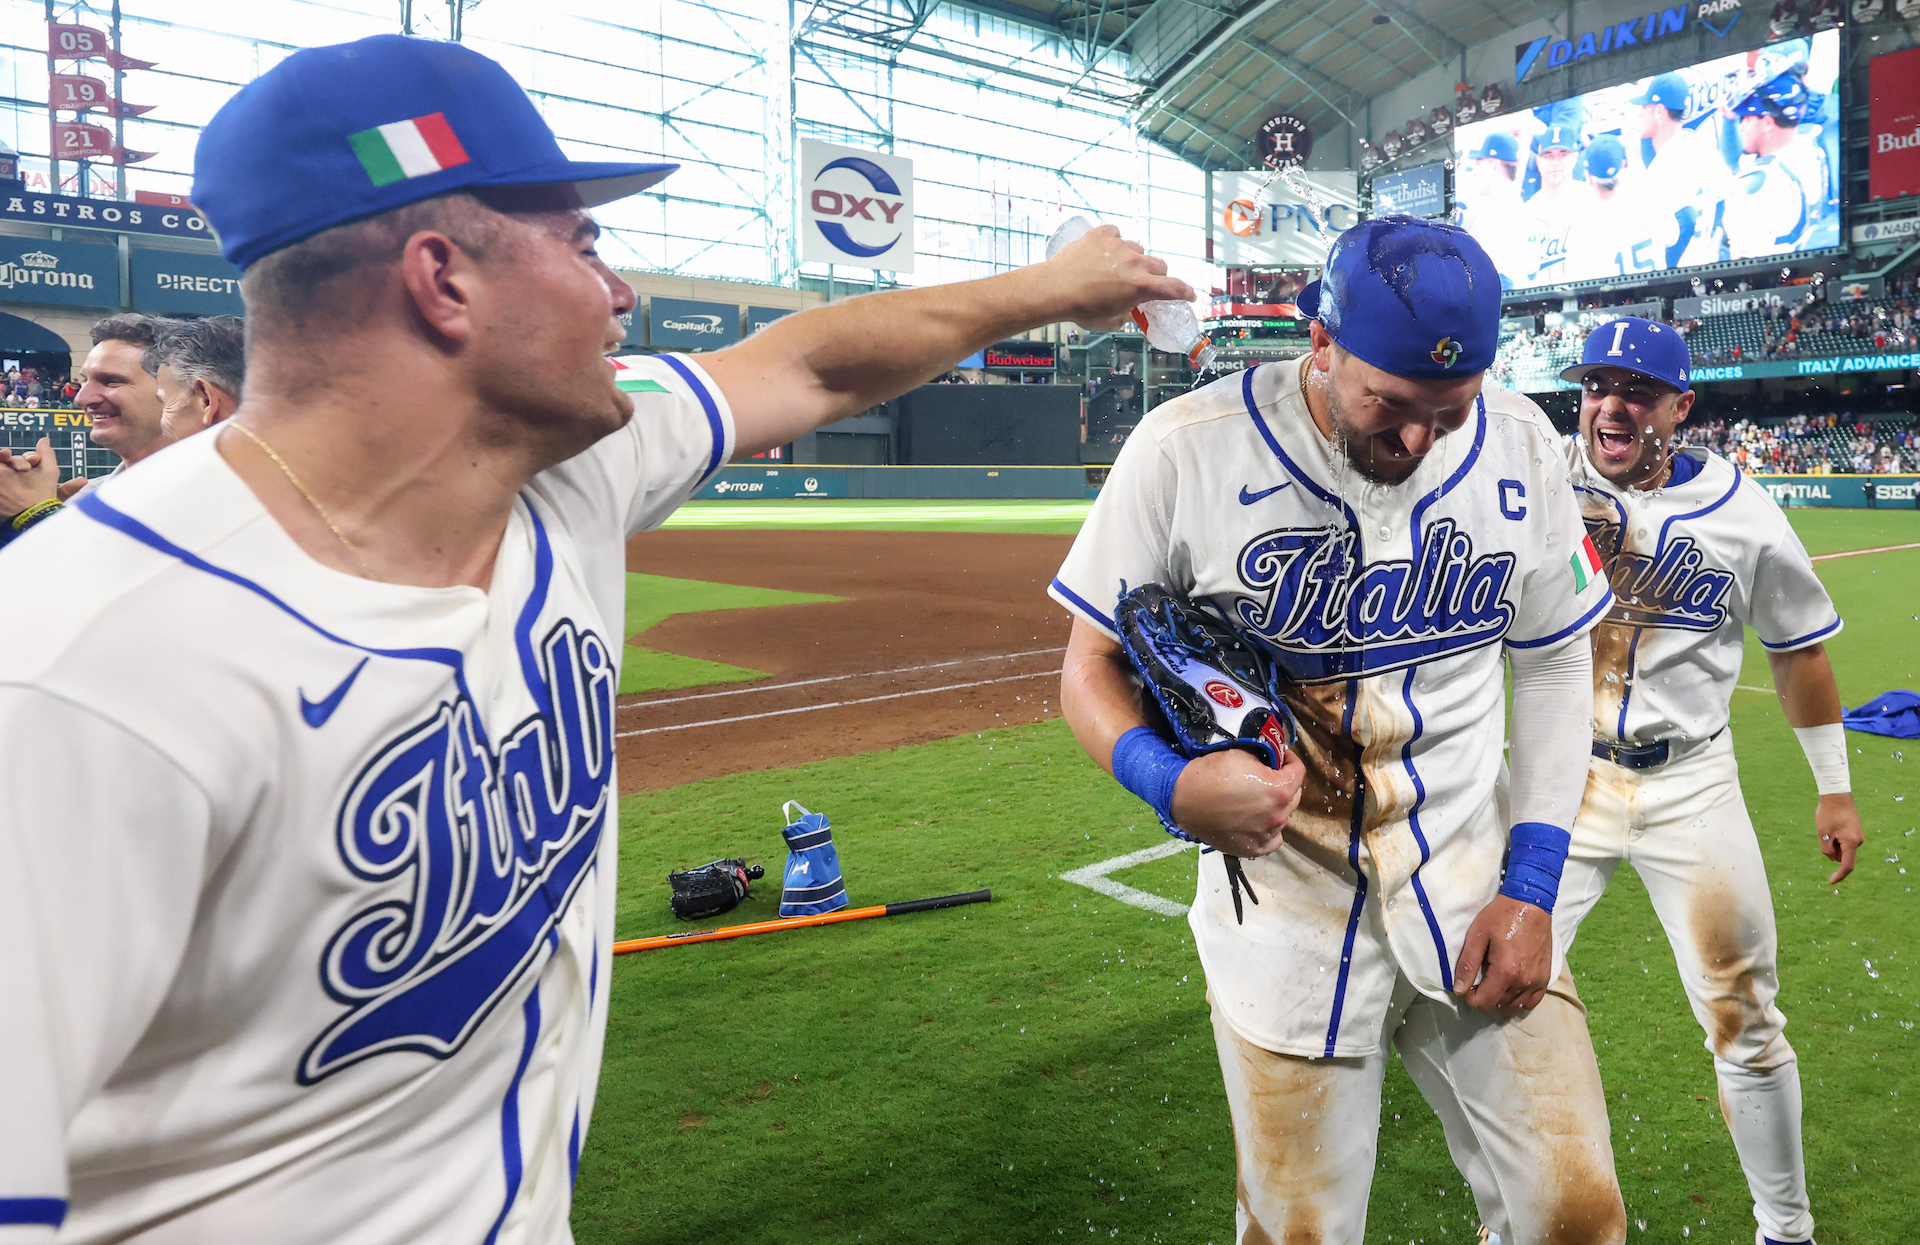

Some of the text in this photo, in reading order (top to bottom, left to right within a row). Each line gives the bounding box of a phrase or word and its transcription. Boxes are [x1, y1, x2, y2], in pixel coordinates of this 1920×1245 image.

[1698, 0, 1742, 18] PARK
[60, 32, 94, 51] 05
[1547, 5, 1688, 67] DAIKIN
[64, 84, 95, 101] 19
[1262, 115, 1306, 133] HOUSTON
[63, 131, 94, 147] 21
[1273, 132, 1294, 152] H
[1877, 127, 1920, 153] Bud
[1264, 153, 1304, 168] ASTROS
[1380, 182, 1438, 205] ethodist
[6, 197, 205, 231] ASTROS CO
[811, 189, 904, 224] OXY
[1268, 203, 1349, 232] PNC
[1614, 238, 1656, 276] 15
[0, 260, 94, 290] Corona
[1607, 322, 1629, 356] I
[986, 353, 1055, 366] Budweiser
[1798, 353, 1920, 374] ITALY ADVANCE
[1498, 479, 1527, 521] C
[1236, 518, 1516, 650] Italia
